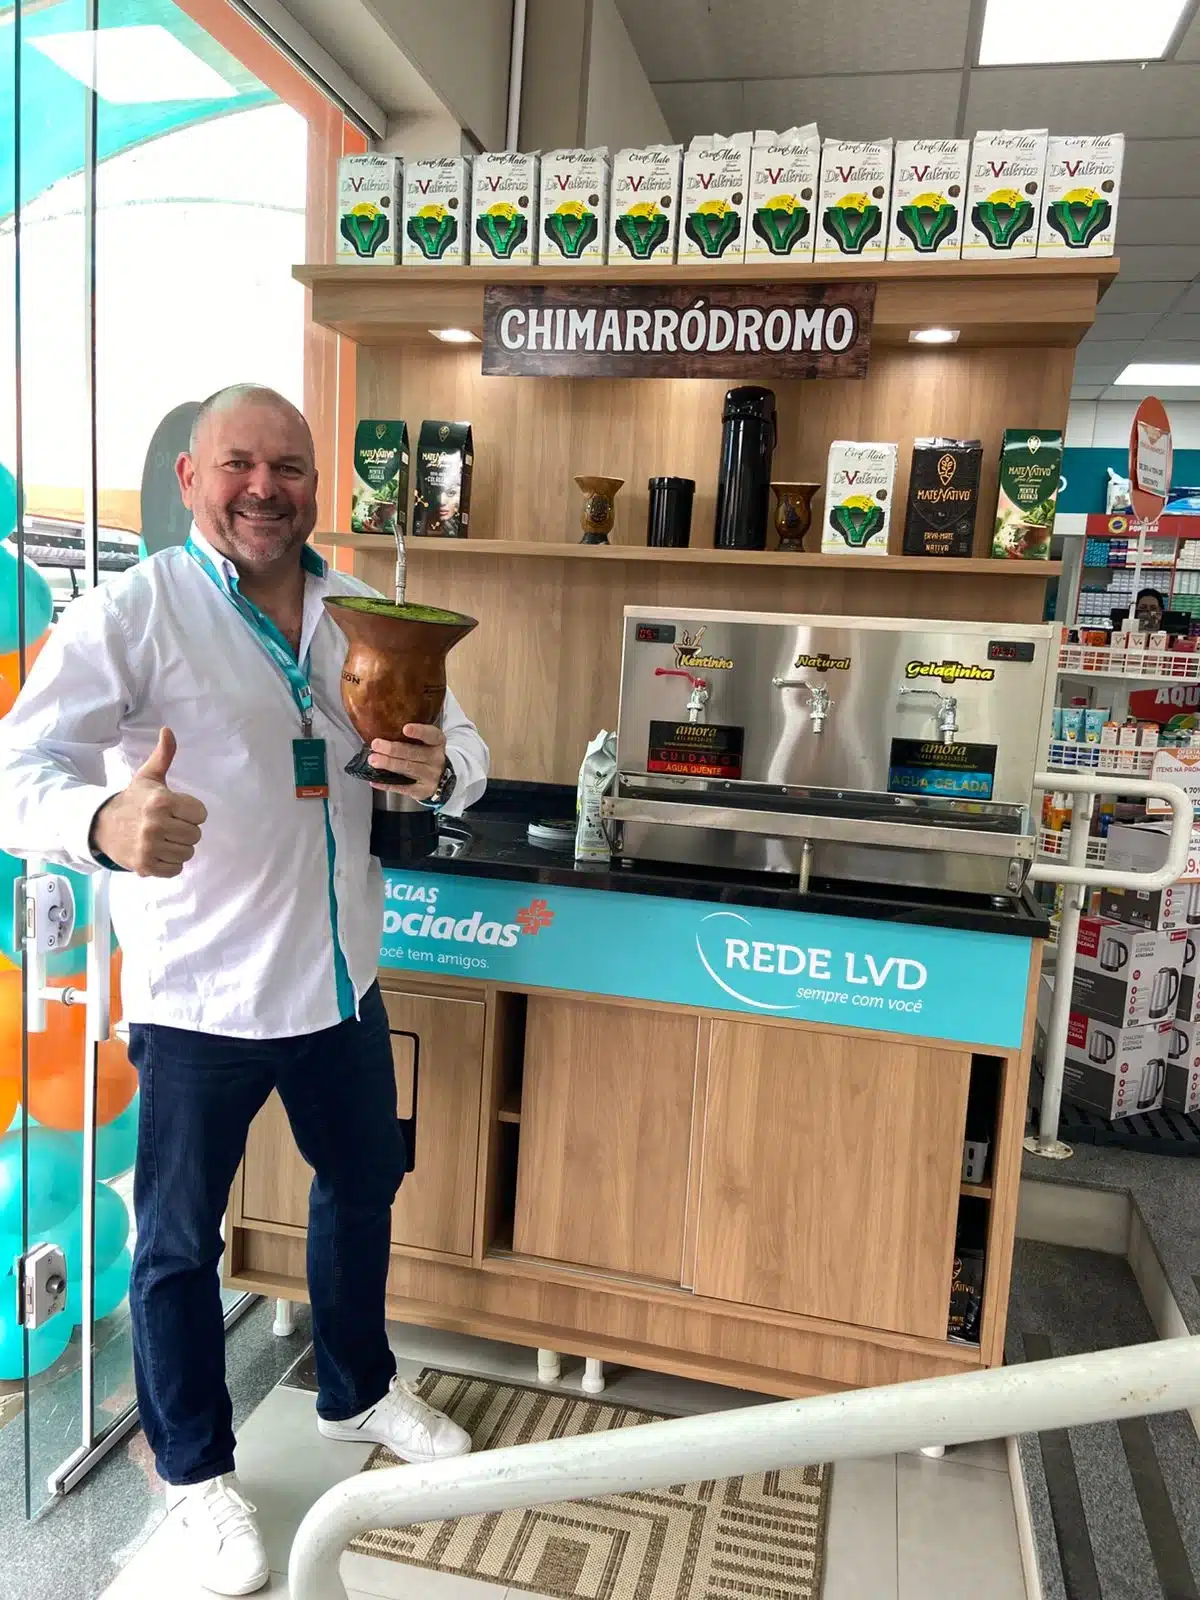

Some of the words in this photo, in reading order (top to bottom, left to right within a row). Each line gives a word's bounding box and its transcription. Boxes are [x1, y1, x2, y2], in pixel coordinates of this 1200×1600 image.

[500, 301, 854, 352] CHIMARRÓDROMO
[797, 655, 850, 669] Natural
[907, 662, 994, 681] Geladinha
[675, 725, 717, 737] amora
[921, 743, 967, 755] amora
[690, 765, 722, 775] QUENTE
[382, 906, 520, 947] ociadas
[407, 948, 433, 963] tem
[437, 953, 490, 970] amigos.
[725, 938, 832, 980] REDE
[844, 951, 928, 990] LVD
[796, 986, 849, 1005] sempre
[851, 993, 884, 1009] com
[887, 998, 923, 1013] você
